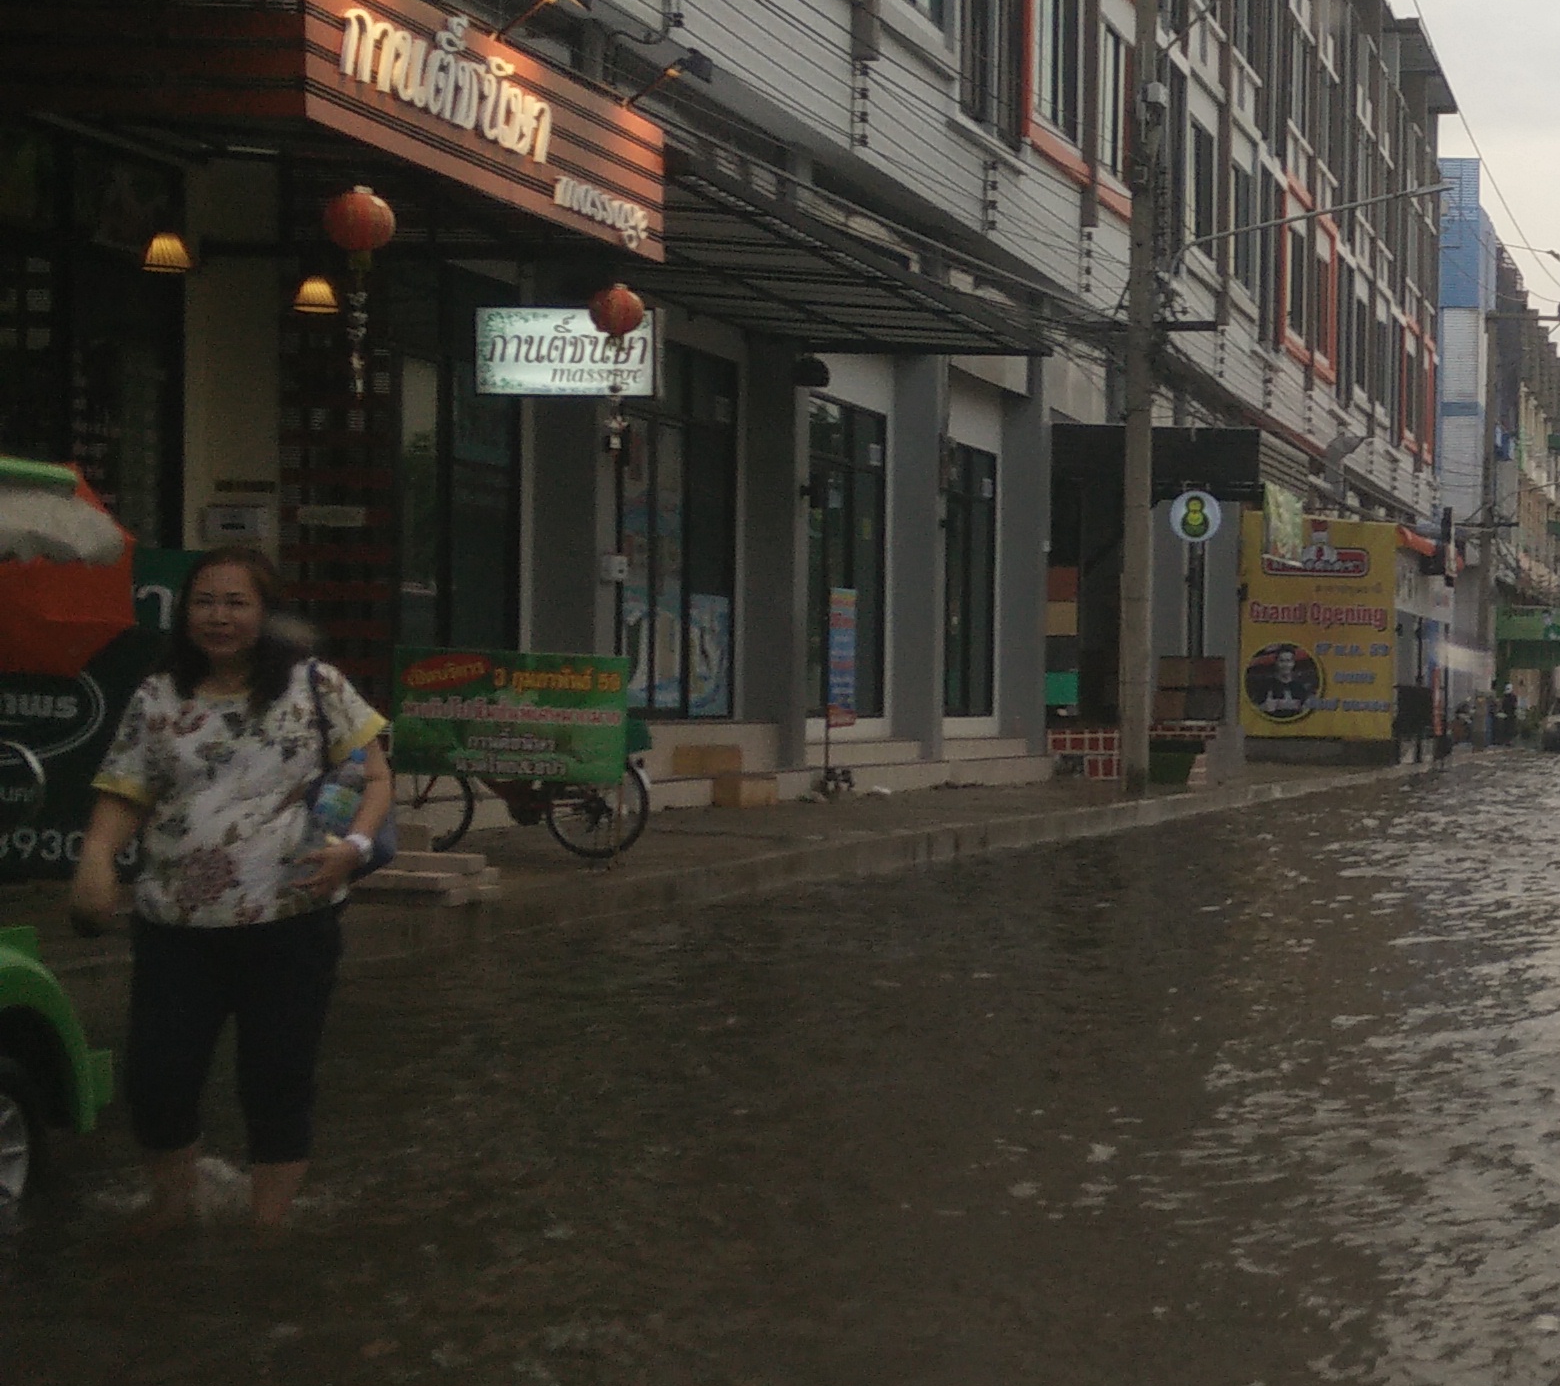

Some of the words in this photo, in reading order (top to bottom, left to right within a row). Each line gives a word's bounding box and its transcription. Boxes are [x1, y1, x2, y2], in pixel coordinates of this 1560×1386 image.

[488, 314, 649, 365] กานติ์ชนษา
[1249, 600, 1306, 624] Grand
[1310, 601, 1387, 630] Opening
[493, 669, 507, 688] 3
